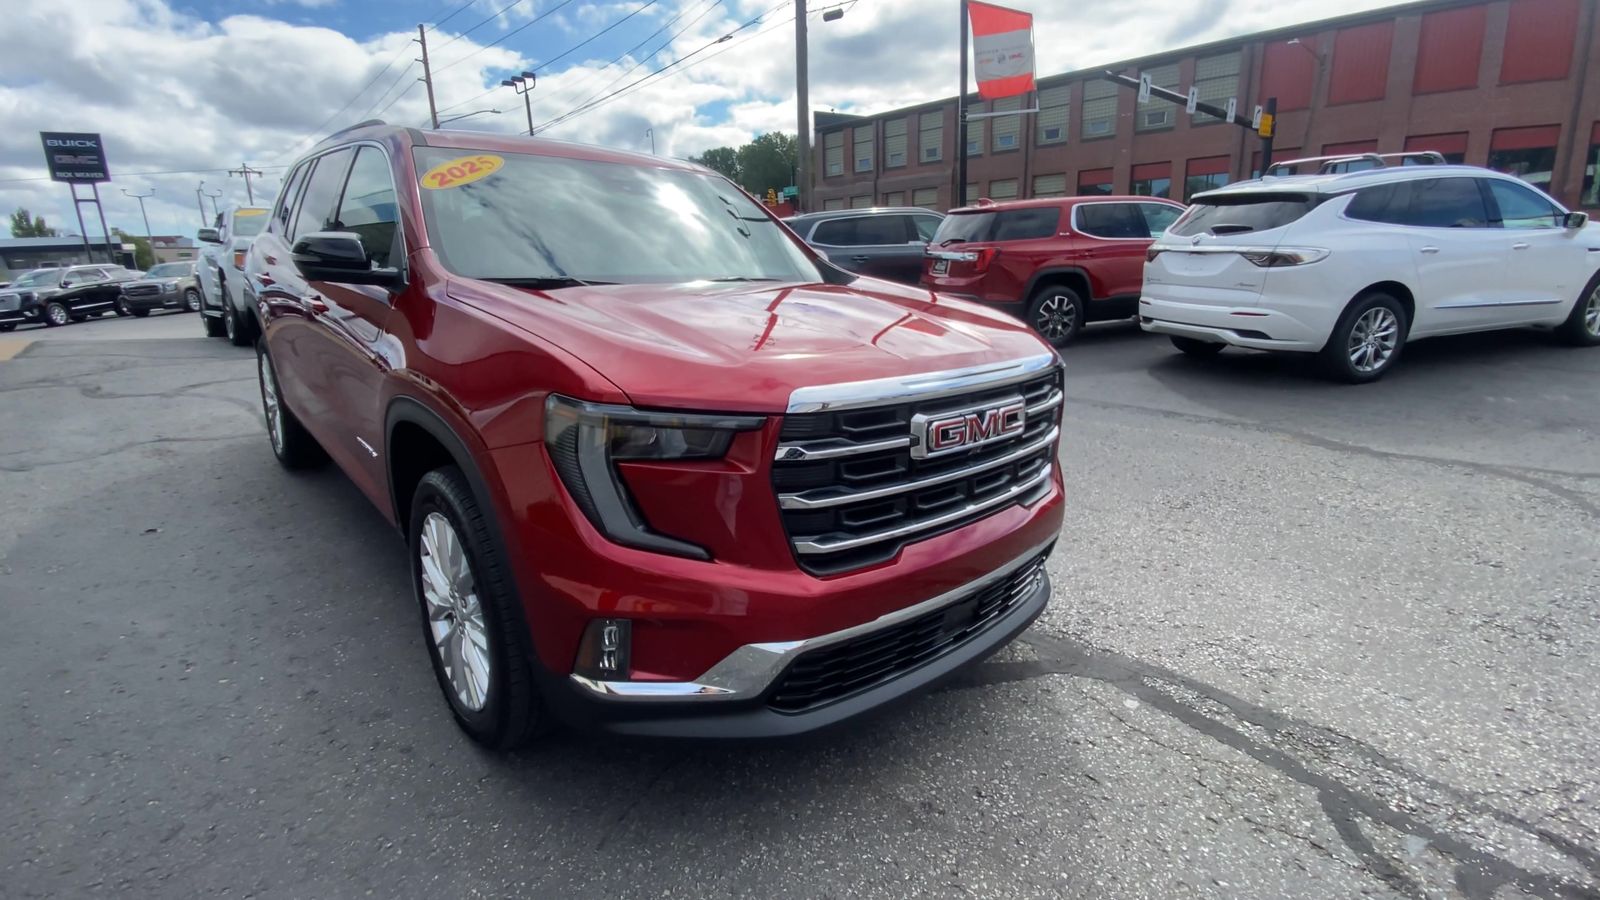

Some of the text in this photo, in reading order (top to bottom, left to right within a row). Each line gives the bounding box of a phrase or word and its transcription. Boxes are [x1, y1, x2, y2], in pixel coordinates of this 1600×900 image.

[47, 139, 97, 147] BUICK
[54, 154, 99, 164] GMC
[430, 156, 496, 187] 2025
[929, 403, 1024, 450] GMC
